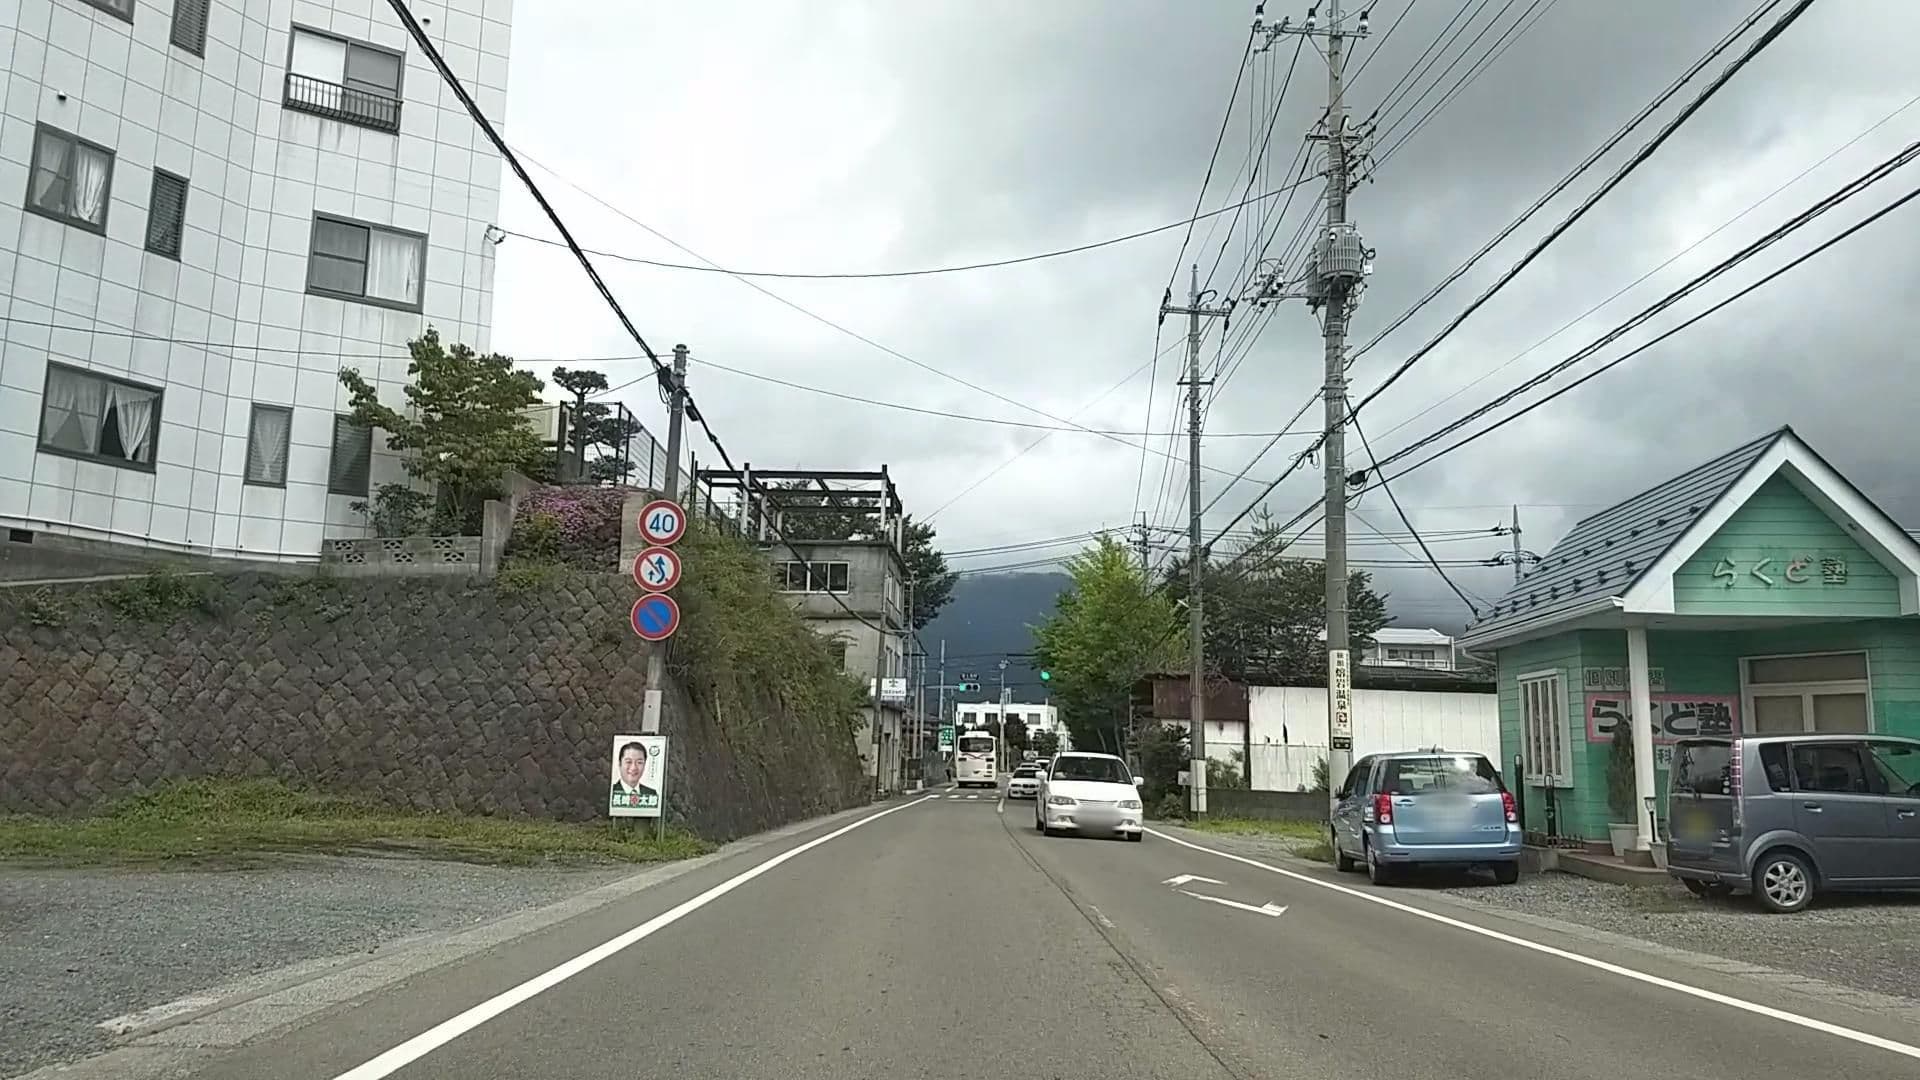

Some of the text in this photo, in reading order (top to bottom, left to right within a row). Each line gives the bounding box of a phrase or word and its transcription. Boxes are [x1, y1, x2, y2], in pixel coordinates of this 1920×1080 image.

[649, 512, 675, 533] 40
[1712, 555, 1848, 587] らくど塾
[1586, 669, 1664, 686] 個別習
